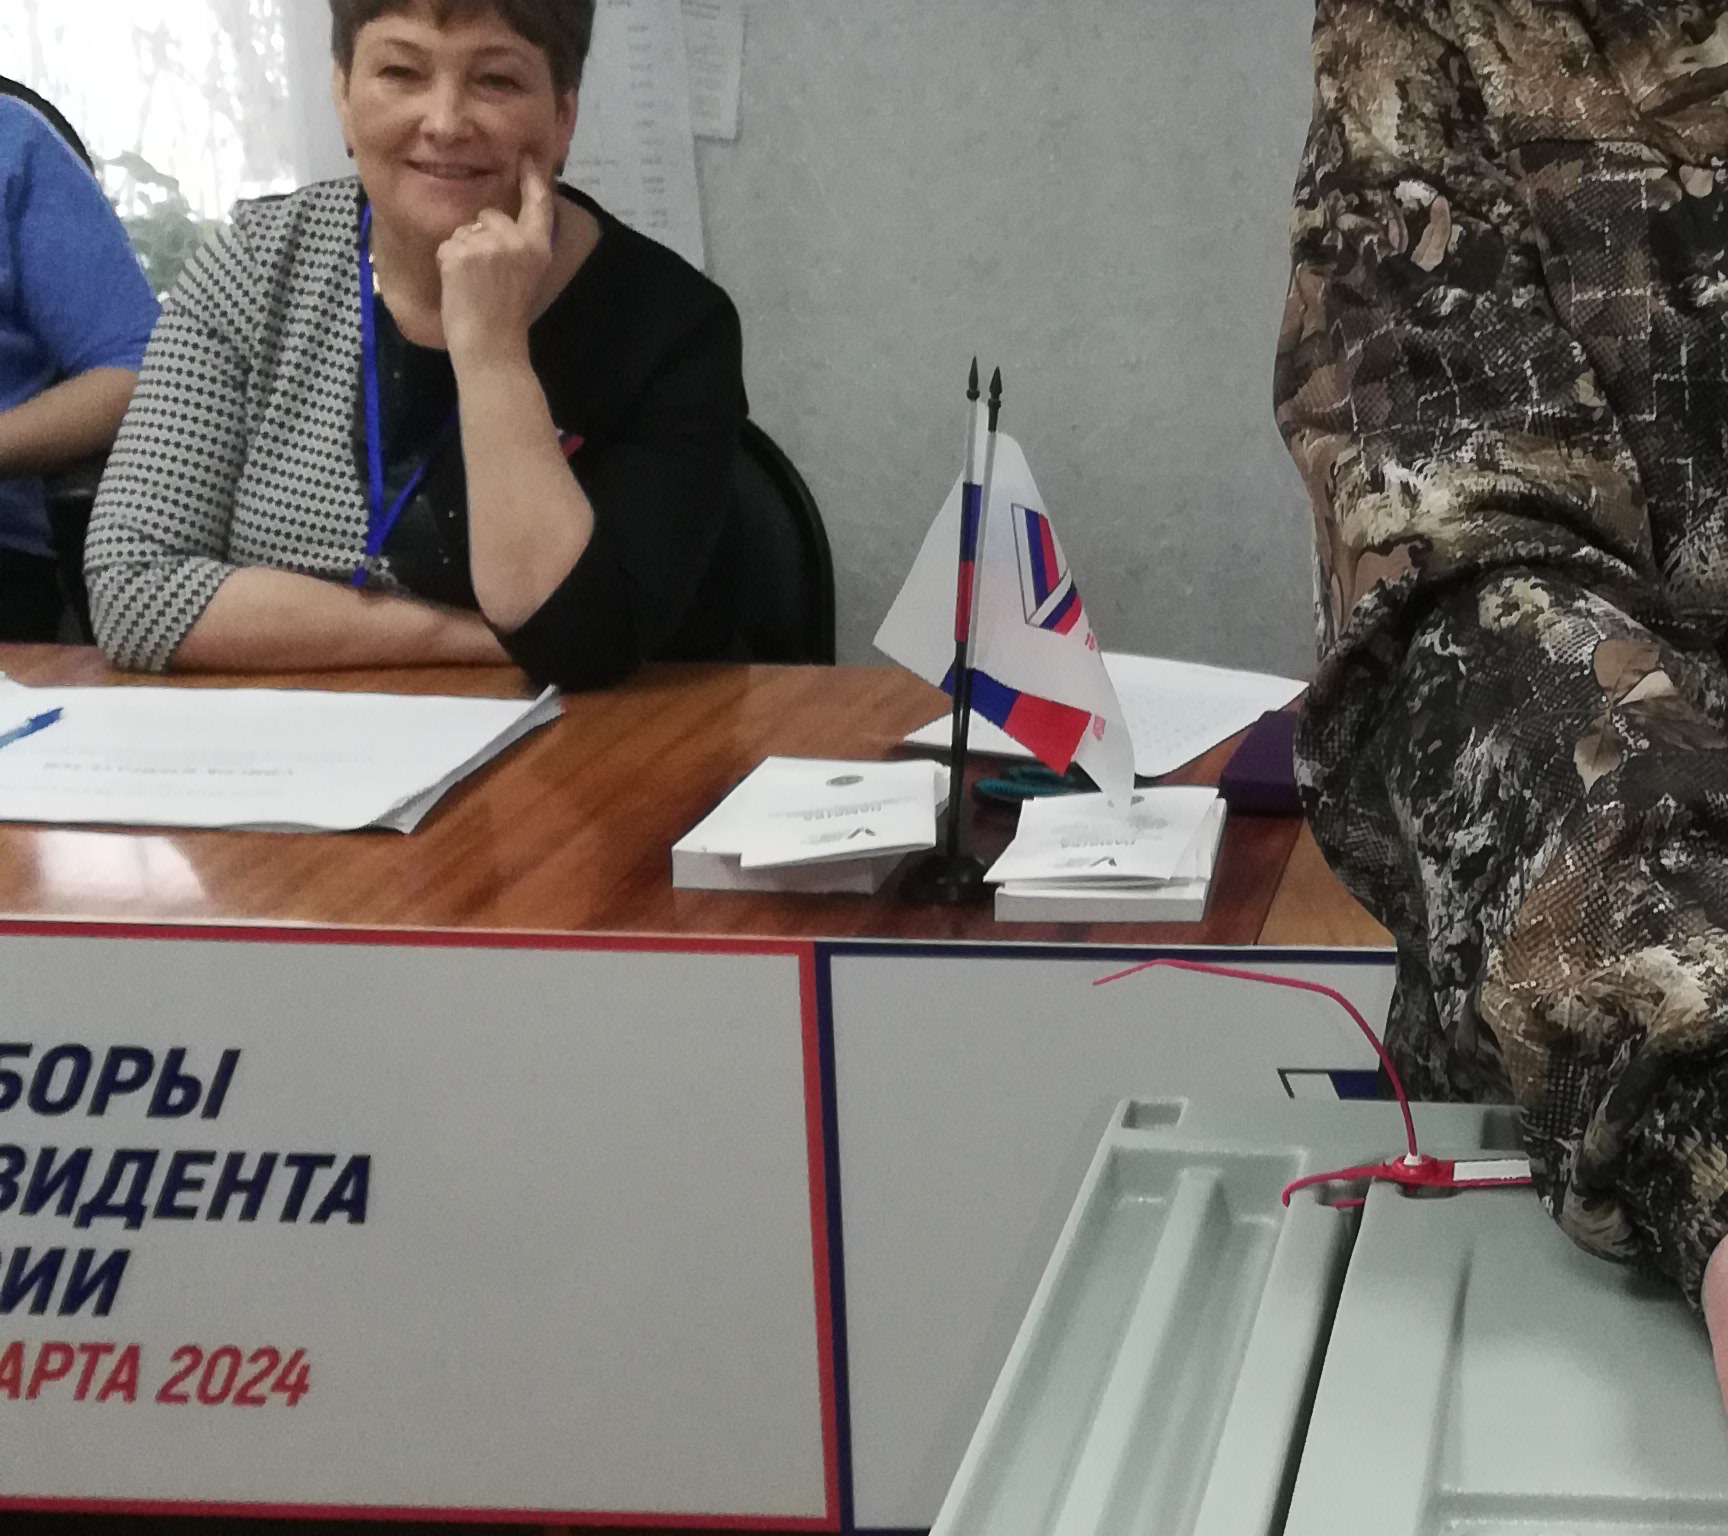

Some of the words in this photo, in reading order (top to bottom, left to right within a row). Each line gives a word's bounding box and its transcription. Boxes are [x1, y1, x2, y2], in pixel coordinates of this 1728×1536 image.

[0, 1041, 241, 1120] БОРЫ
[0, 1340, 140, 1403] АРТА
[155, 1344, 310, 1407] 2024
